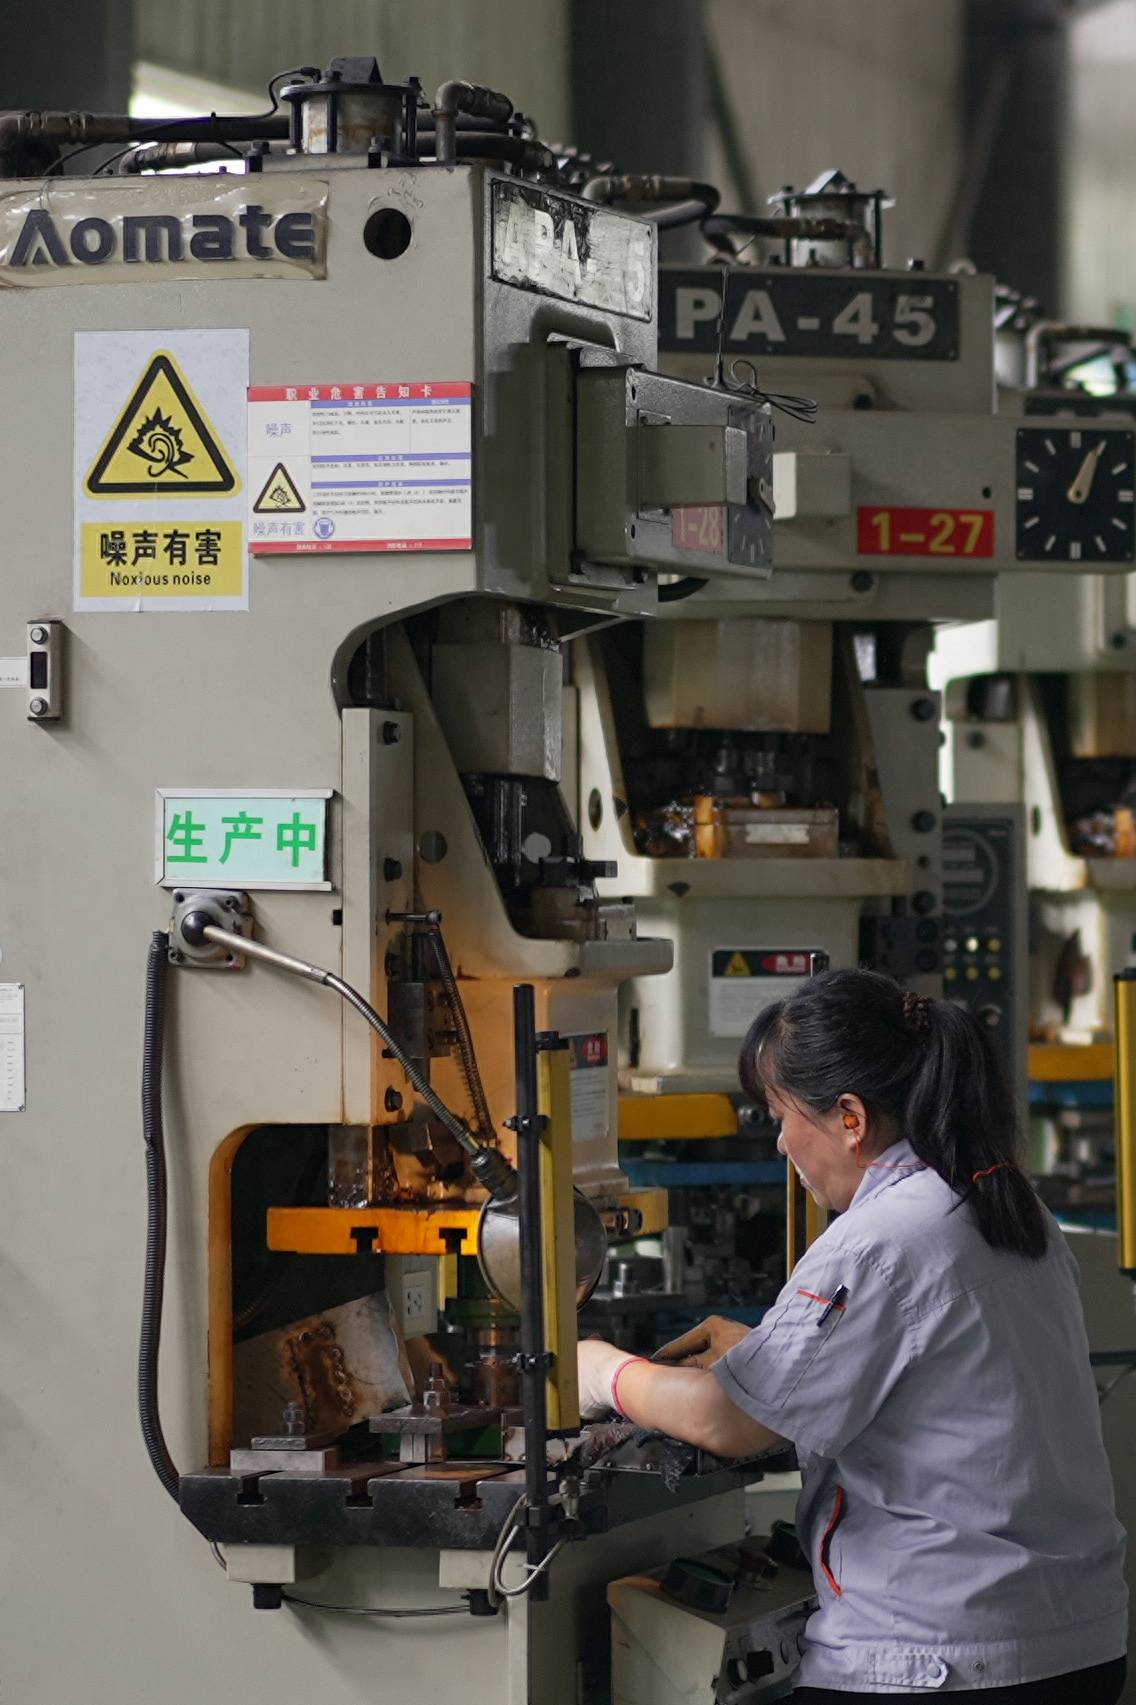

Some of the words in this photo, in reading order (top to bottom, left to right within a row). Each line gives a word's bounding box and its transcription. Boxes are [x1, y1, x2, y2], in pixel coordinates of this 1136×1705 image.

[9, 205, 316, 265] Aomate
[657, 286, 937, 347] PA-45
[285, 385, 433, 401] 职业危害告知卡
[266, 422, 293, 438] 噪声
[253, 520, 306, 537] 噪声有害
[680, 507, 720, 547] 1-28
[872, 511, 984, 553] 1-27
[100, 528, 222, 567] 噪声有害
[110, 571, 169, 586] Noxious
[173, 571, 211, 586] noise
[166, 810, 317, 868] 生产中
